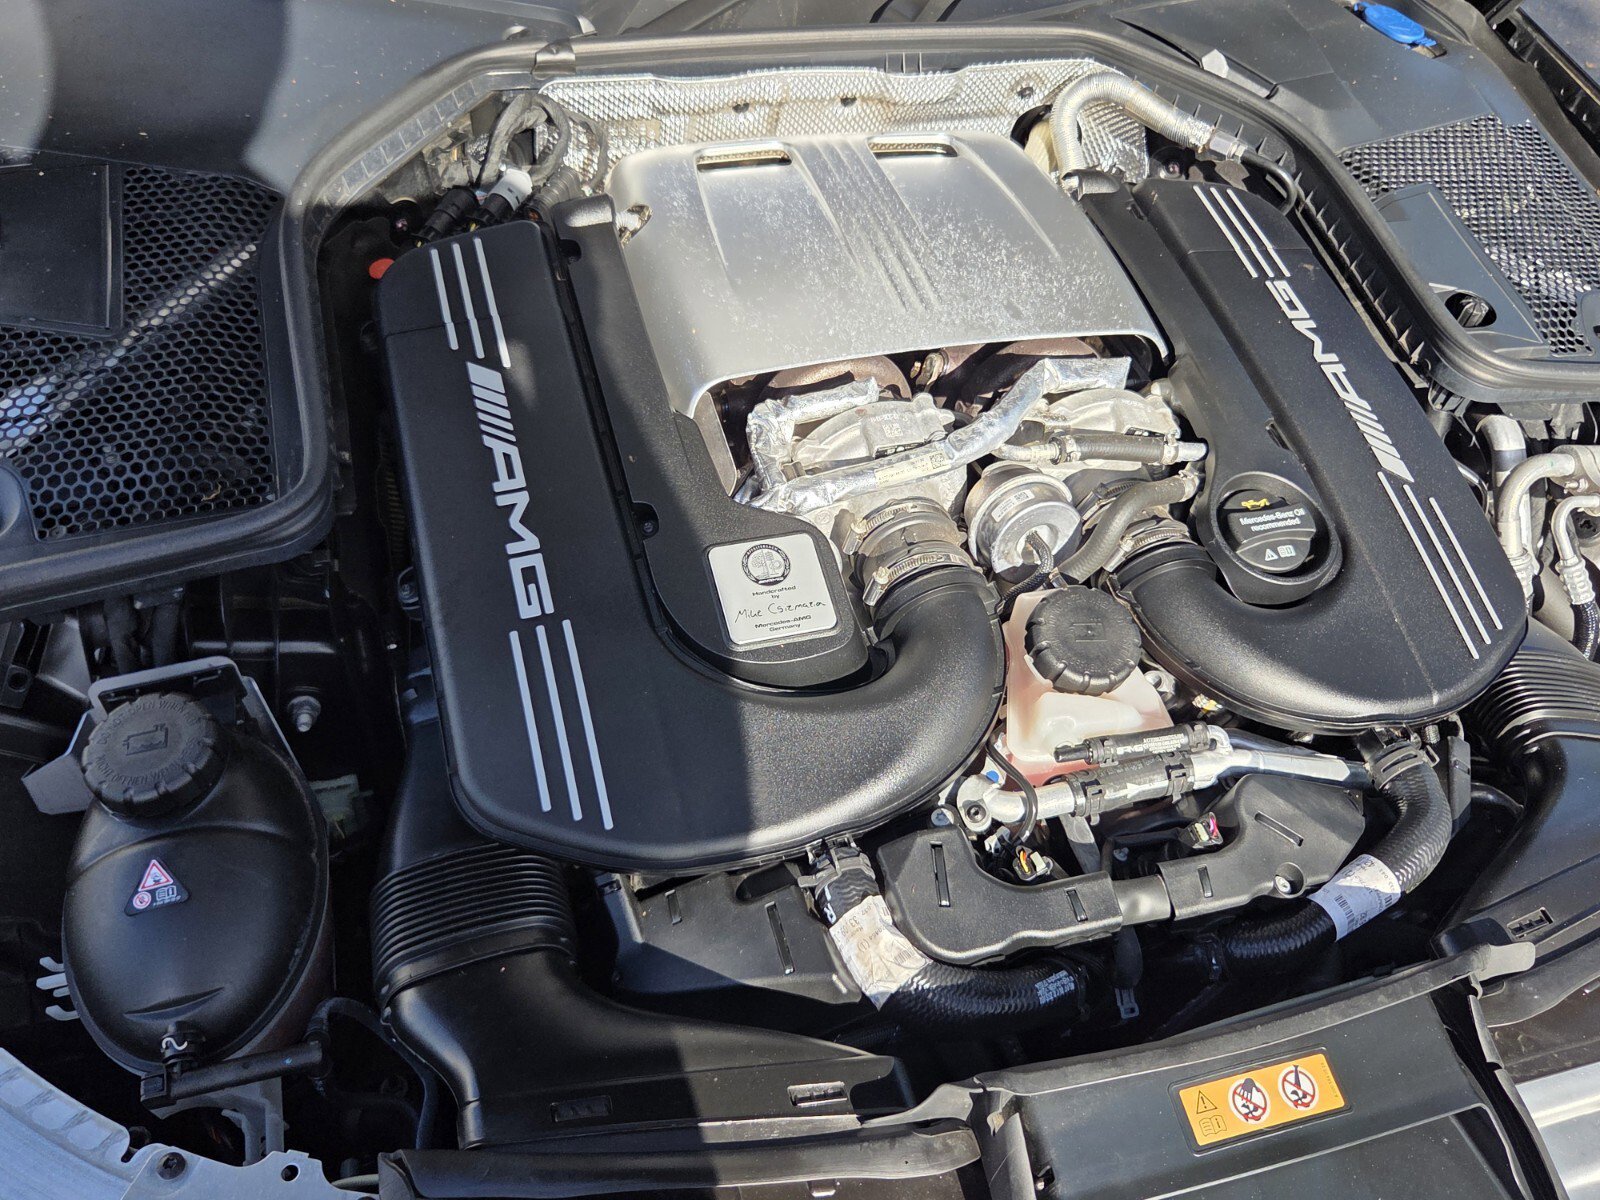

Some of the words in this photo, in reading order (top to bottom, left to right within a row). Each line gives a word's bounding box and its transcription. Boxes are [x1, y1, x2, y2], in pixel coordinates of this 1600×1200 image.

[1265, 280, 1372, 411] AMG
[1239, 510, 1294, 526] Mercedes-Benz
[1294, 508, 1306, 517] Oil
[1251, 517, 1301, 532] recommended
[482, 434, 555, 620] AMG
[752, 585, 796, 597] Handcrafted
[754, 614, 812, 629] Mercedes-AMG
[769, 623, 801, 632] Germany
[159, 700, 186, 714] WHEN
